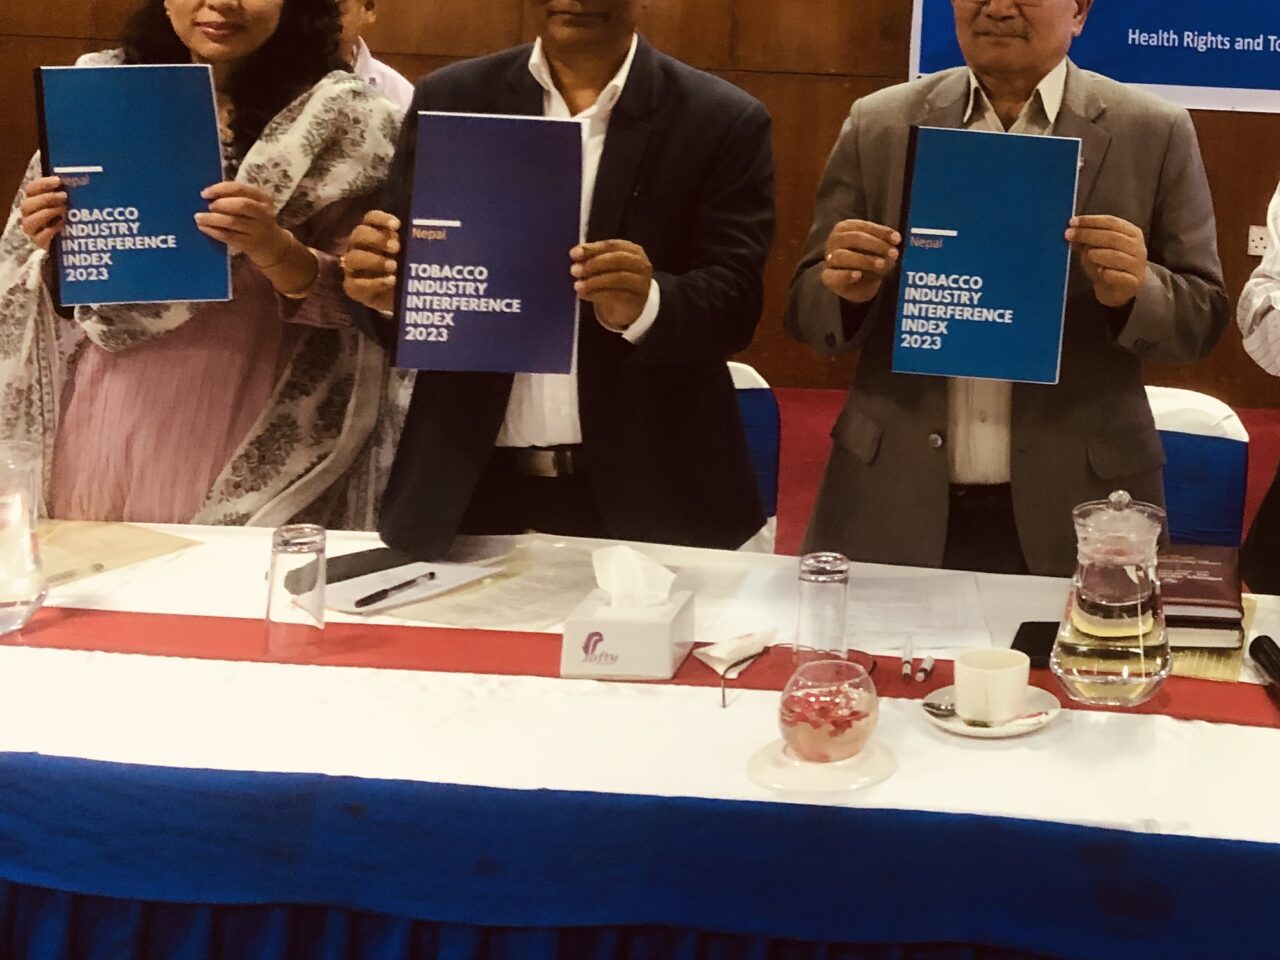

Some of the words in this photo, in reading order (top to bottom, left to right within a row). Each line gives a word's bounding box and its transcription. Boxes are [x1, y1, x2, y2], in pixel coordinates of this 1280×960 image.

[1128, 28, 1179, 47] Health
[1183, 31, 1230, 52] Rights
[1234, 34, 1263, 51] and
[67, 206, 139, 222] OBACCO
[411, 227, 447, 242] Nepal
[61, 235, 177, 252] INTERFERENCE
[910, 236, 943, 250] Nepal
[63, 252, 113, 267] INDEX
[65, 267, 109, 281] 2023
[408, 263, 488, 280] TOBACCO
[407, 279, 488, 296] INDUSTRY
[906, 271, 983, 289] TOBACCO
[406, 295, 522, 312] INTERFERENCE
[904, 287, 982, 305] INDUSTRY
[405, 311, 455, 326] INDEX
[903, 303, 1014, 323] INTERFERENCE
[404, 326, 449, 342] 2023
[901, 318, 948, 334] INDEX
[900, 334, 942, 350] 2023
